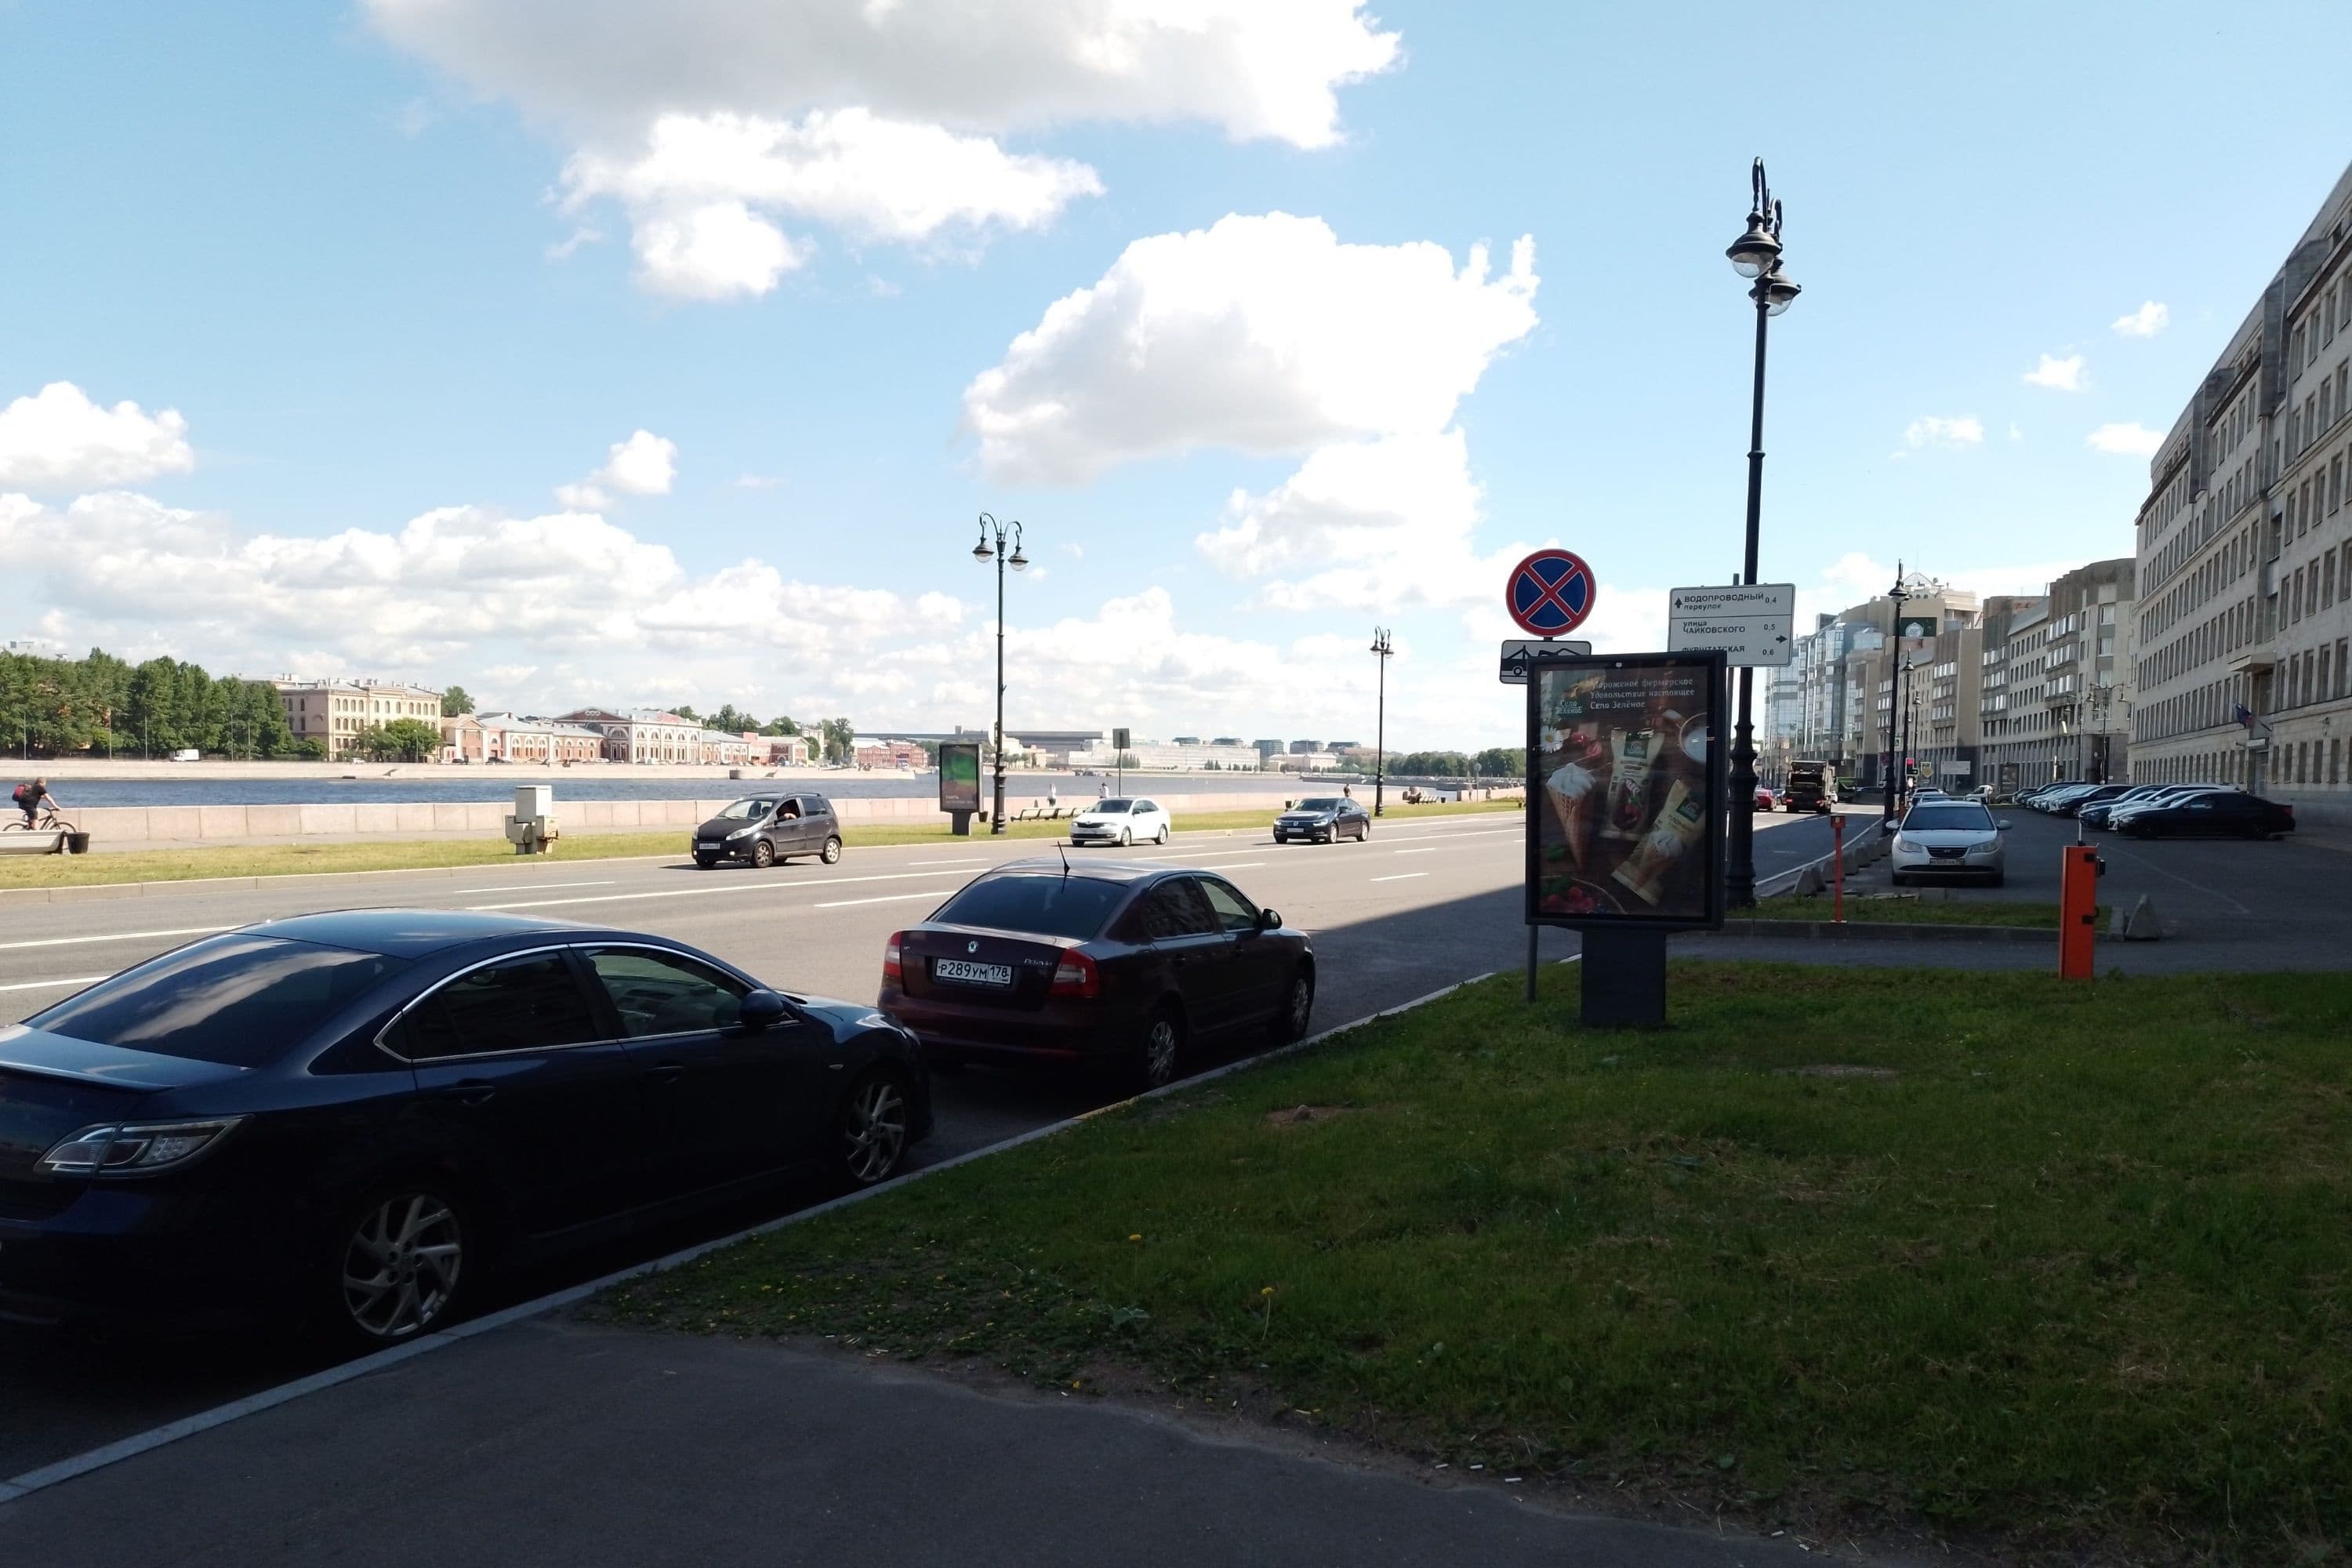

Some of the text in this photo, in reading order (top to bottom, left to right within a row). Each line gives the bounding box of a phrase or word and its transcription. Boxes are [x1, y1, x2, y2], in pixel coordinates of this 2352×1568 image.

[1684, 593, 1764, 603] ВОДОПРОВОДНЫЙ
[1683, 626, 1745, 634] ЧАЙКОВСКОГО
[989, 965, 1007, 978] 178
